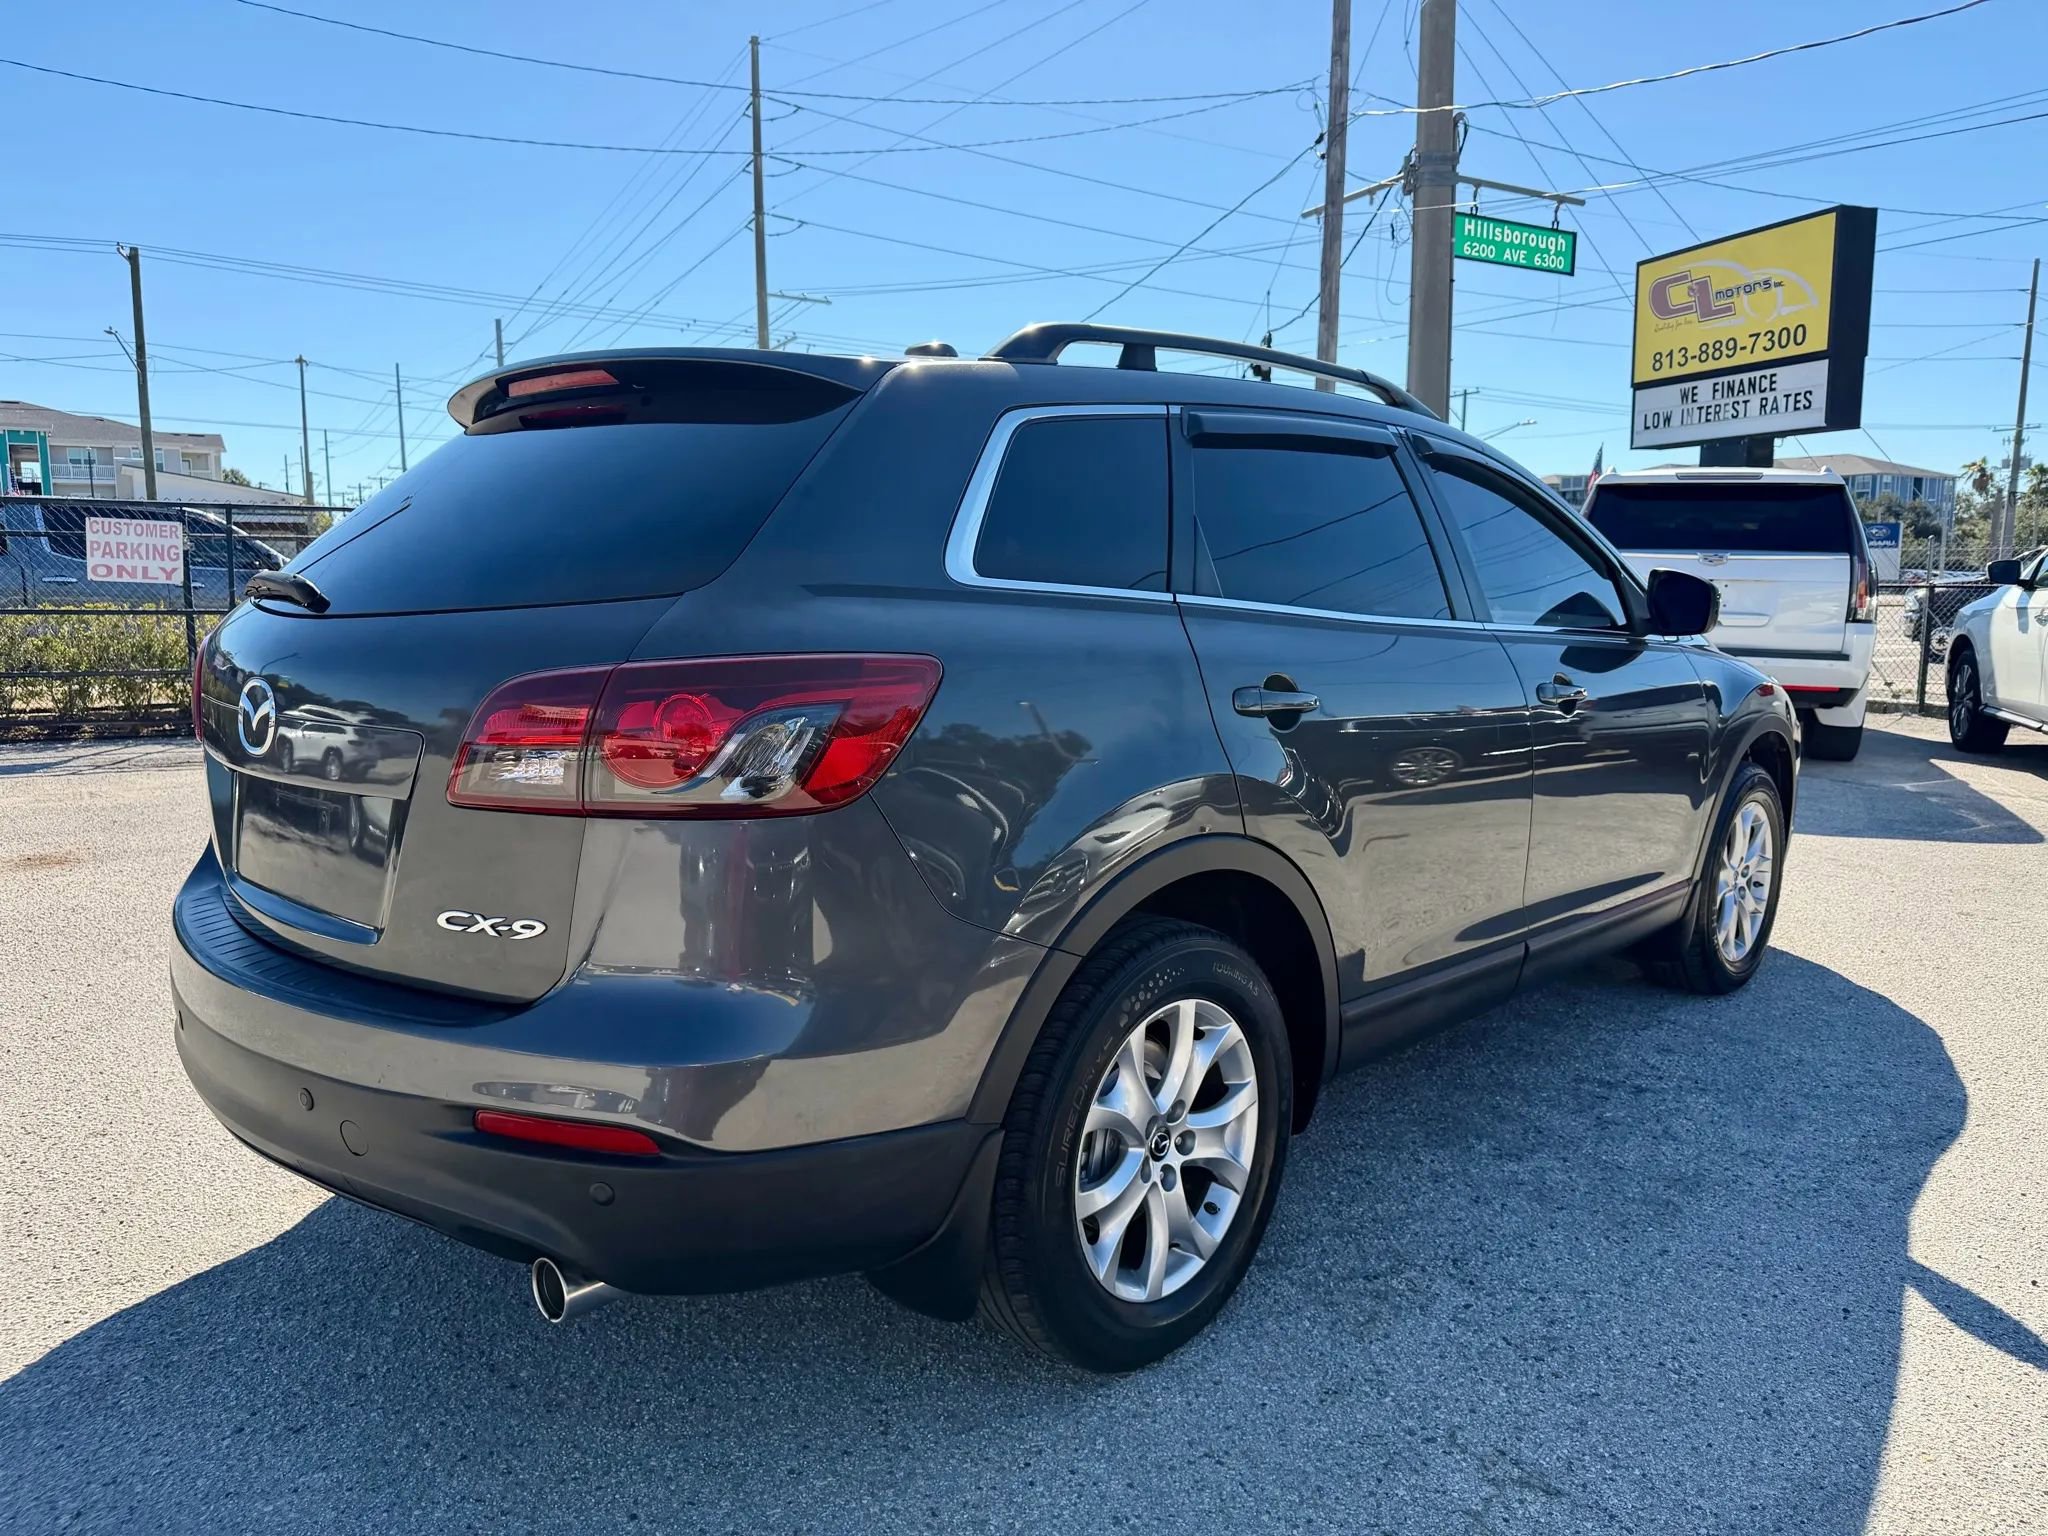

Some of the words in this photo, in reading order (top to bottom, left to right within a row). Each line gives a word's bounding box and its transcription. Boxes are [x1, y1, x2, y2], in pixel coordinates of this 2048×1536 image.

[1464, 218, 1566, 255] Hillsborough
[1463, 242, 1496, 259] 6200
[1503, 248, 1527, 263] AVE
[1534, 253, 1565, 269] 6300
[1652, 323, 1807, 372] 813-889-7300
[1680, 385, 1698, 405] WE
[1712, 373, 1777, 400] FINANCE
[1644, 410, 1673, 430] LOW
[1681, 400, 1750, 426] INTEREST
[1759, 390, 1813, 416] RATES
[88, 520, 179, 540] CUSTOMER
[89, 540, 180, 562] PARKING
[91, 563, 178, 581] ONLY
[437, 910, 547, 940] CX-9
